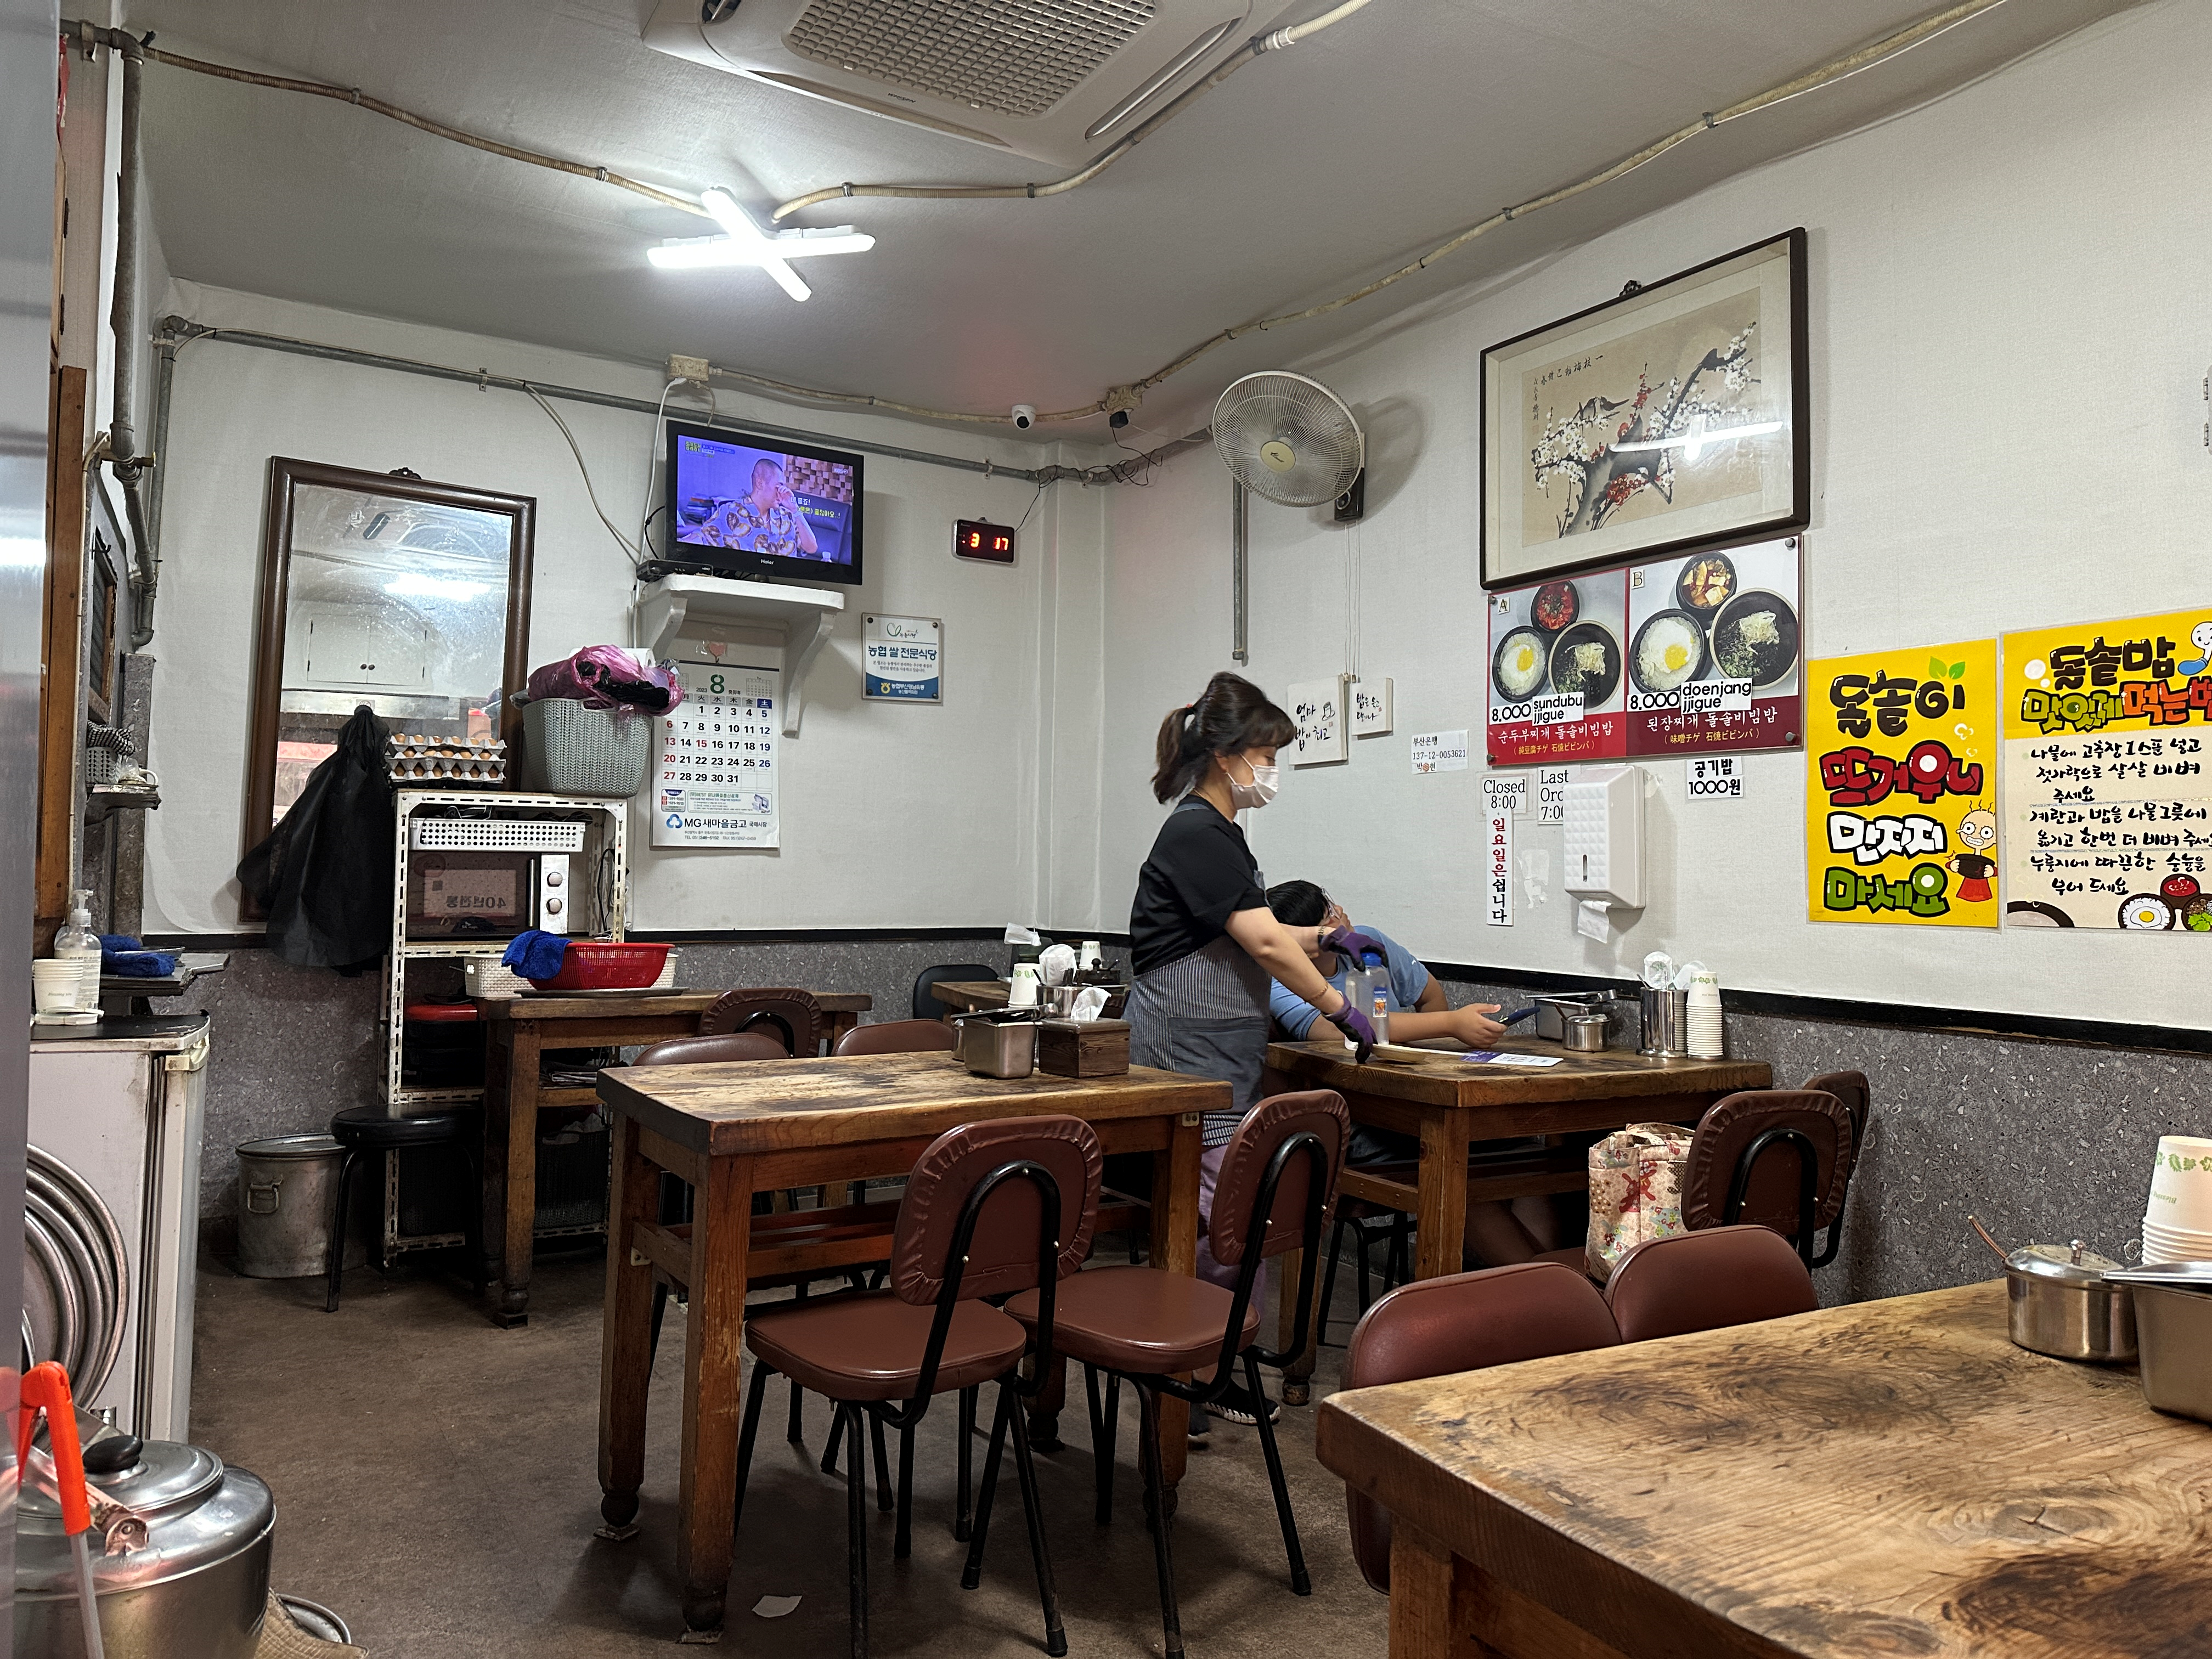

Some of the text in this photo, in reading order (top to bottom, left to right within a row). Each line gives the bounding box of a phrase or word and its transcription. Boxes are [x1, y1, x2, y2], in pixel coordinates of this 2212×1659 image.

[970, 533, 1009, 550] 3 17
[1632, 572, 1643, 587] B
[1498, 599, 1508, 612] A
[868, 646, 937, 661] 농협 쌀 전문식당
[2050, 636, 2176, 691] 돌솥밥
[710, 674, 725, 694] 8
[1682, 681, 1752, 697] doenjang
[1356, 693, 1369, 709] 밥은
[1533, 695, 1583, 710] sundubu
[1630, 691, 1679, 710] 8.000
[1683, 696, 1722, 713] jjigue
[1829, 669, 1966, 739] 돌솥이
[1296, 703, 1316, 723] 엄마
[1492, 703, 1531, 722] 8.000
[1533, 708, 1564, 724] jjigue
[1646, 713, 1699, 732] 된장찌개
[1313, 725, 1331, 740] 최고
[1498, 726, 1550, 744] 순두부찌개
[664, 737, 676, 746] 13
[680, 738, 691, 747] 14
[696, 740, 707, 748] 15
[728, 741, 740, 749] 17
[1413, 736, 1437, 747] 부산은행
[2031, 744, 2076, 761] 나물에
[2083, 740, 2123, 759] 고추장
[2170, 738, 2202, 755] 넣고
[664, 754, 676, 763] 20
[695, 757, 707, 765] 22
[1413, 749, 1465, 760] 137-12-0053621
[1417, 762, 1436, 771] 박현
[1695, 758, 1733, 778] 공기밥
[1819, 740, 1984, 807] 뜨거우니
[2036, 760, 2200, 783] 젓가락으로 살살 비벼
[680, 772, 692, 781] 28
[695, 774, 707, 782] 29
[1540, 770, 1569, 784] Last
[1483, 779, 1526, 793] Closed
[1689, 778, 1740, 795] 1000원
[2053, 786, 2095, 803] 주세요
[1491, 795, 1516, 809] 8:00
[1541, 805, 1564, 820] 7:0
[2029, 808, 2085, 824] 계란과
[2089, 805, 2123, 824] 밥을
[1827, 811, 1948, 866] 만지지
[2037, 829, 2073, 848] 옮기고
[2123, 833, 2137, 846] 더
[2142, 832, 2179, 847] 비벼
[2030, 851, 2206, 873] 누룽지에 따끈한 숭늉을
[1823, 862, 1951, 918] 마세요
[2051, 877, 2129, 896] 부어 드세요
